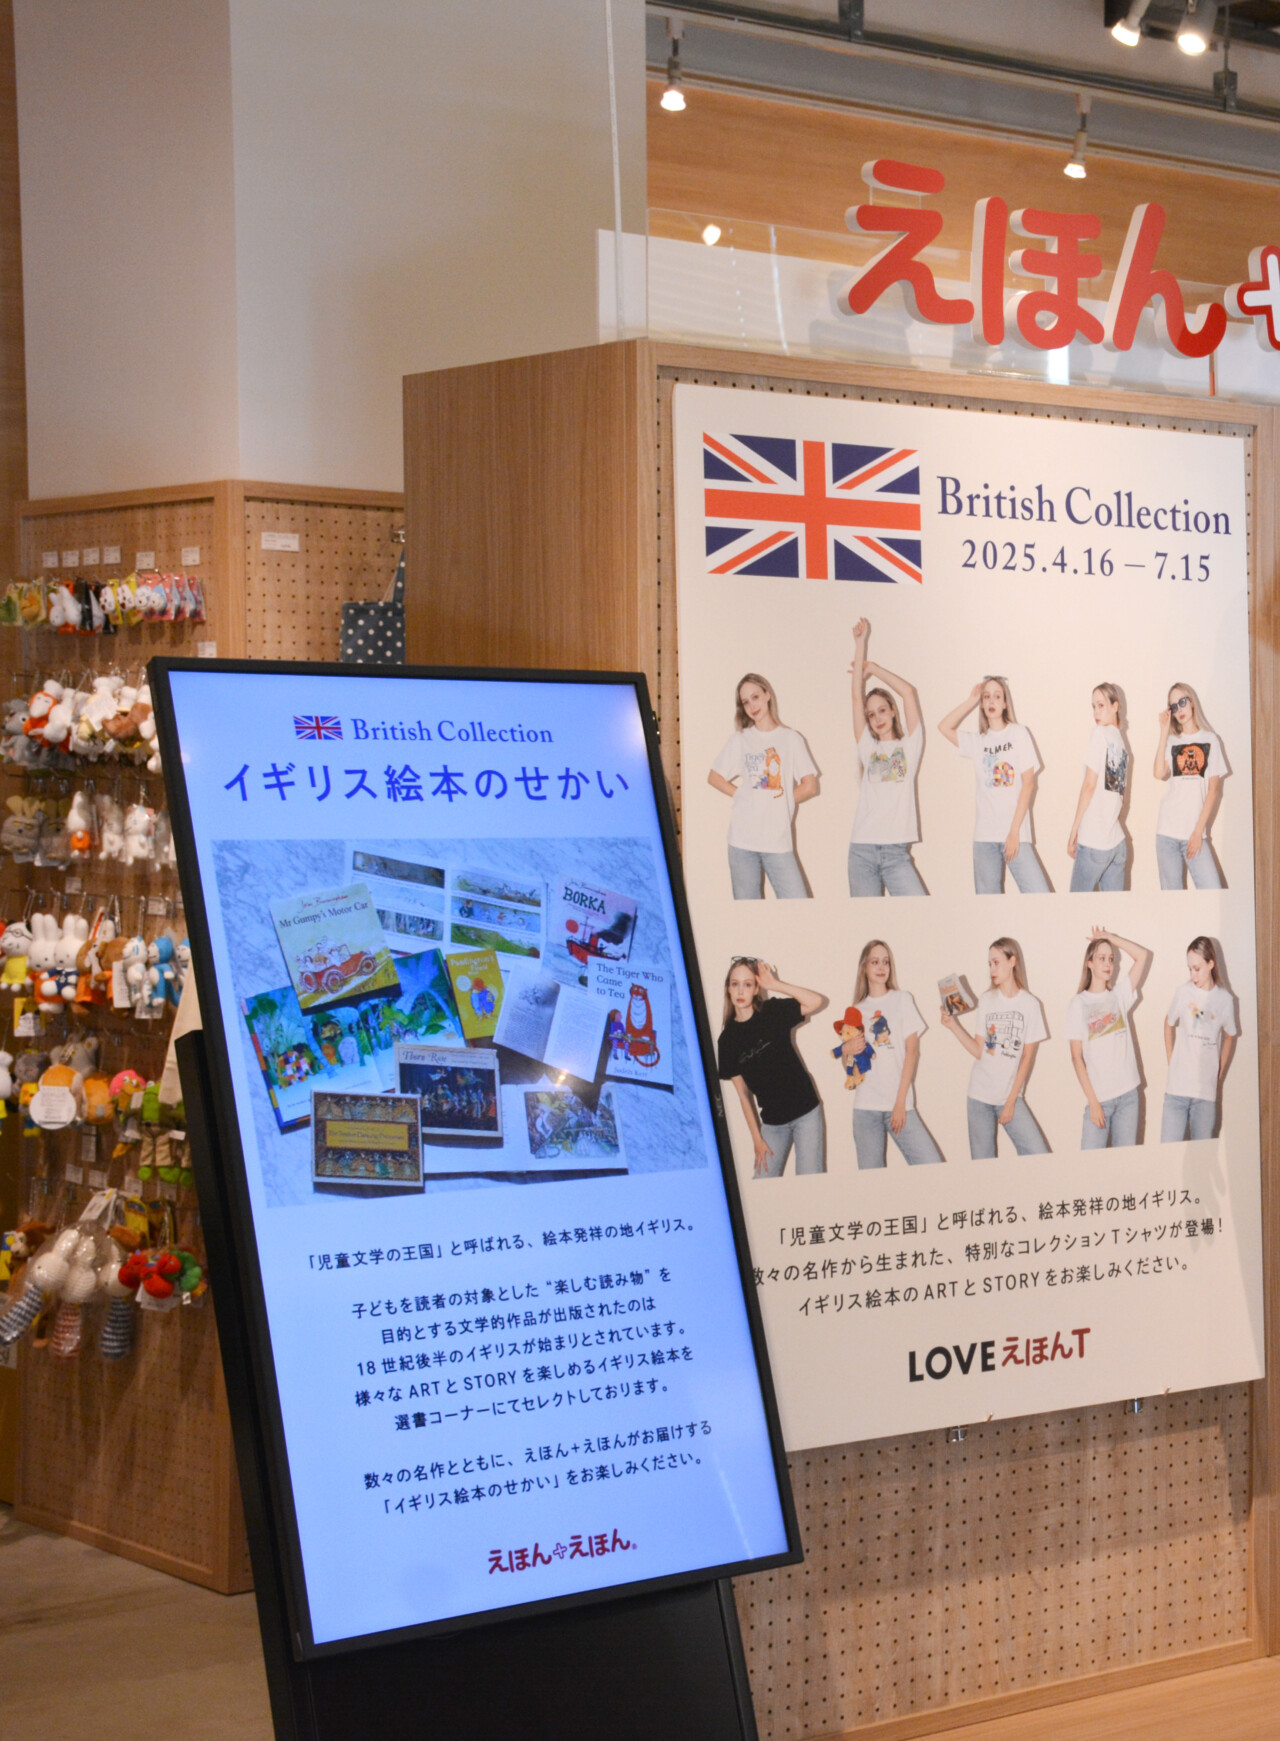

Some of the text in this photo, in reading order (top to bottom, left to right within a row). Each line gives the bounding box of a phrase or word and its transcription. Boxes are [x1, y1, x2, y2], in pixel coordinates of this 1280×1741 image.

[936, 475, 1232, 535] British Collection
[961, 539, 1114, 577] 2025.4.16
[1154, 551, 1211, 582] 7.15
[351, 718, 555, 743] British Collection
[224, 763, 630, 803] イギリス絵本のせかい
[280, 918, 293, 929] Mr
[328, 907, 353, 918] Motor
[354, 901, 369, 911] Car
[563, 886, 606, 915] BORKA
[596, 963, 664, 983] The Tiger Who
[596, 975, 623, 987] Came
[596, 987, 625, 999] to Tea
[780, 1189, 1201, 1247] 「児童文学の王国」と呼ばれる、絵本発祥の地イギリス。
[309, 1218, 694, 1271] 「児童文学の王国」と呼ばれる、絵本発祥の地イギリス。
[381, 1297, 657, 1345] 目的とする文学的作品が出版されたのは
[909, 1327, 1091, 1383] LOVE えほんT
[394, 1378, 669, 1431] 選書コーナーにてセレクトしております。
[384, 1452, 702, 1514] 「イギリス絵本のせかい」をお楽しみください。
